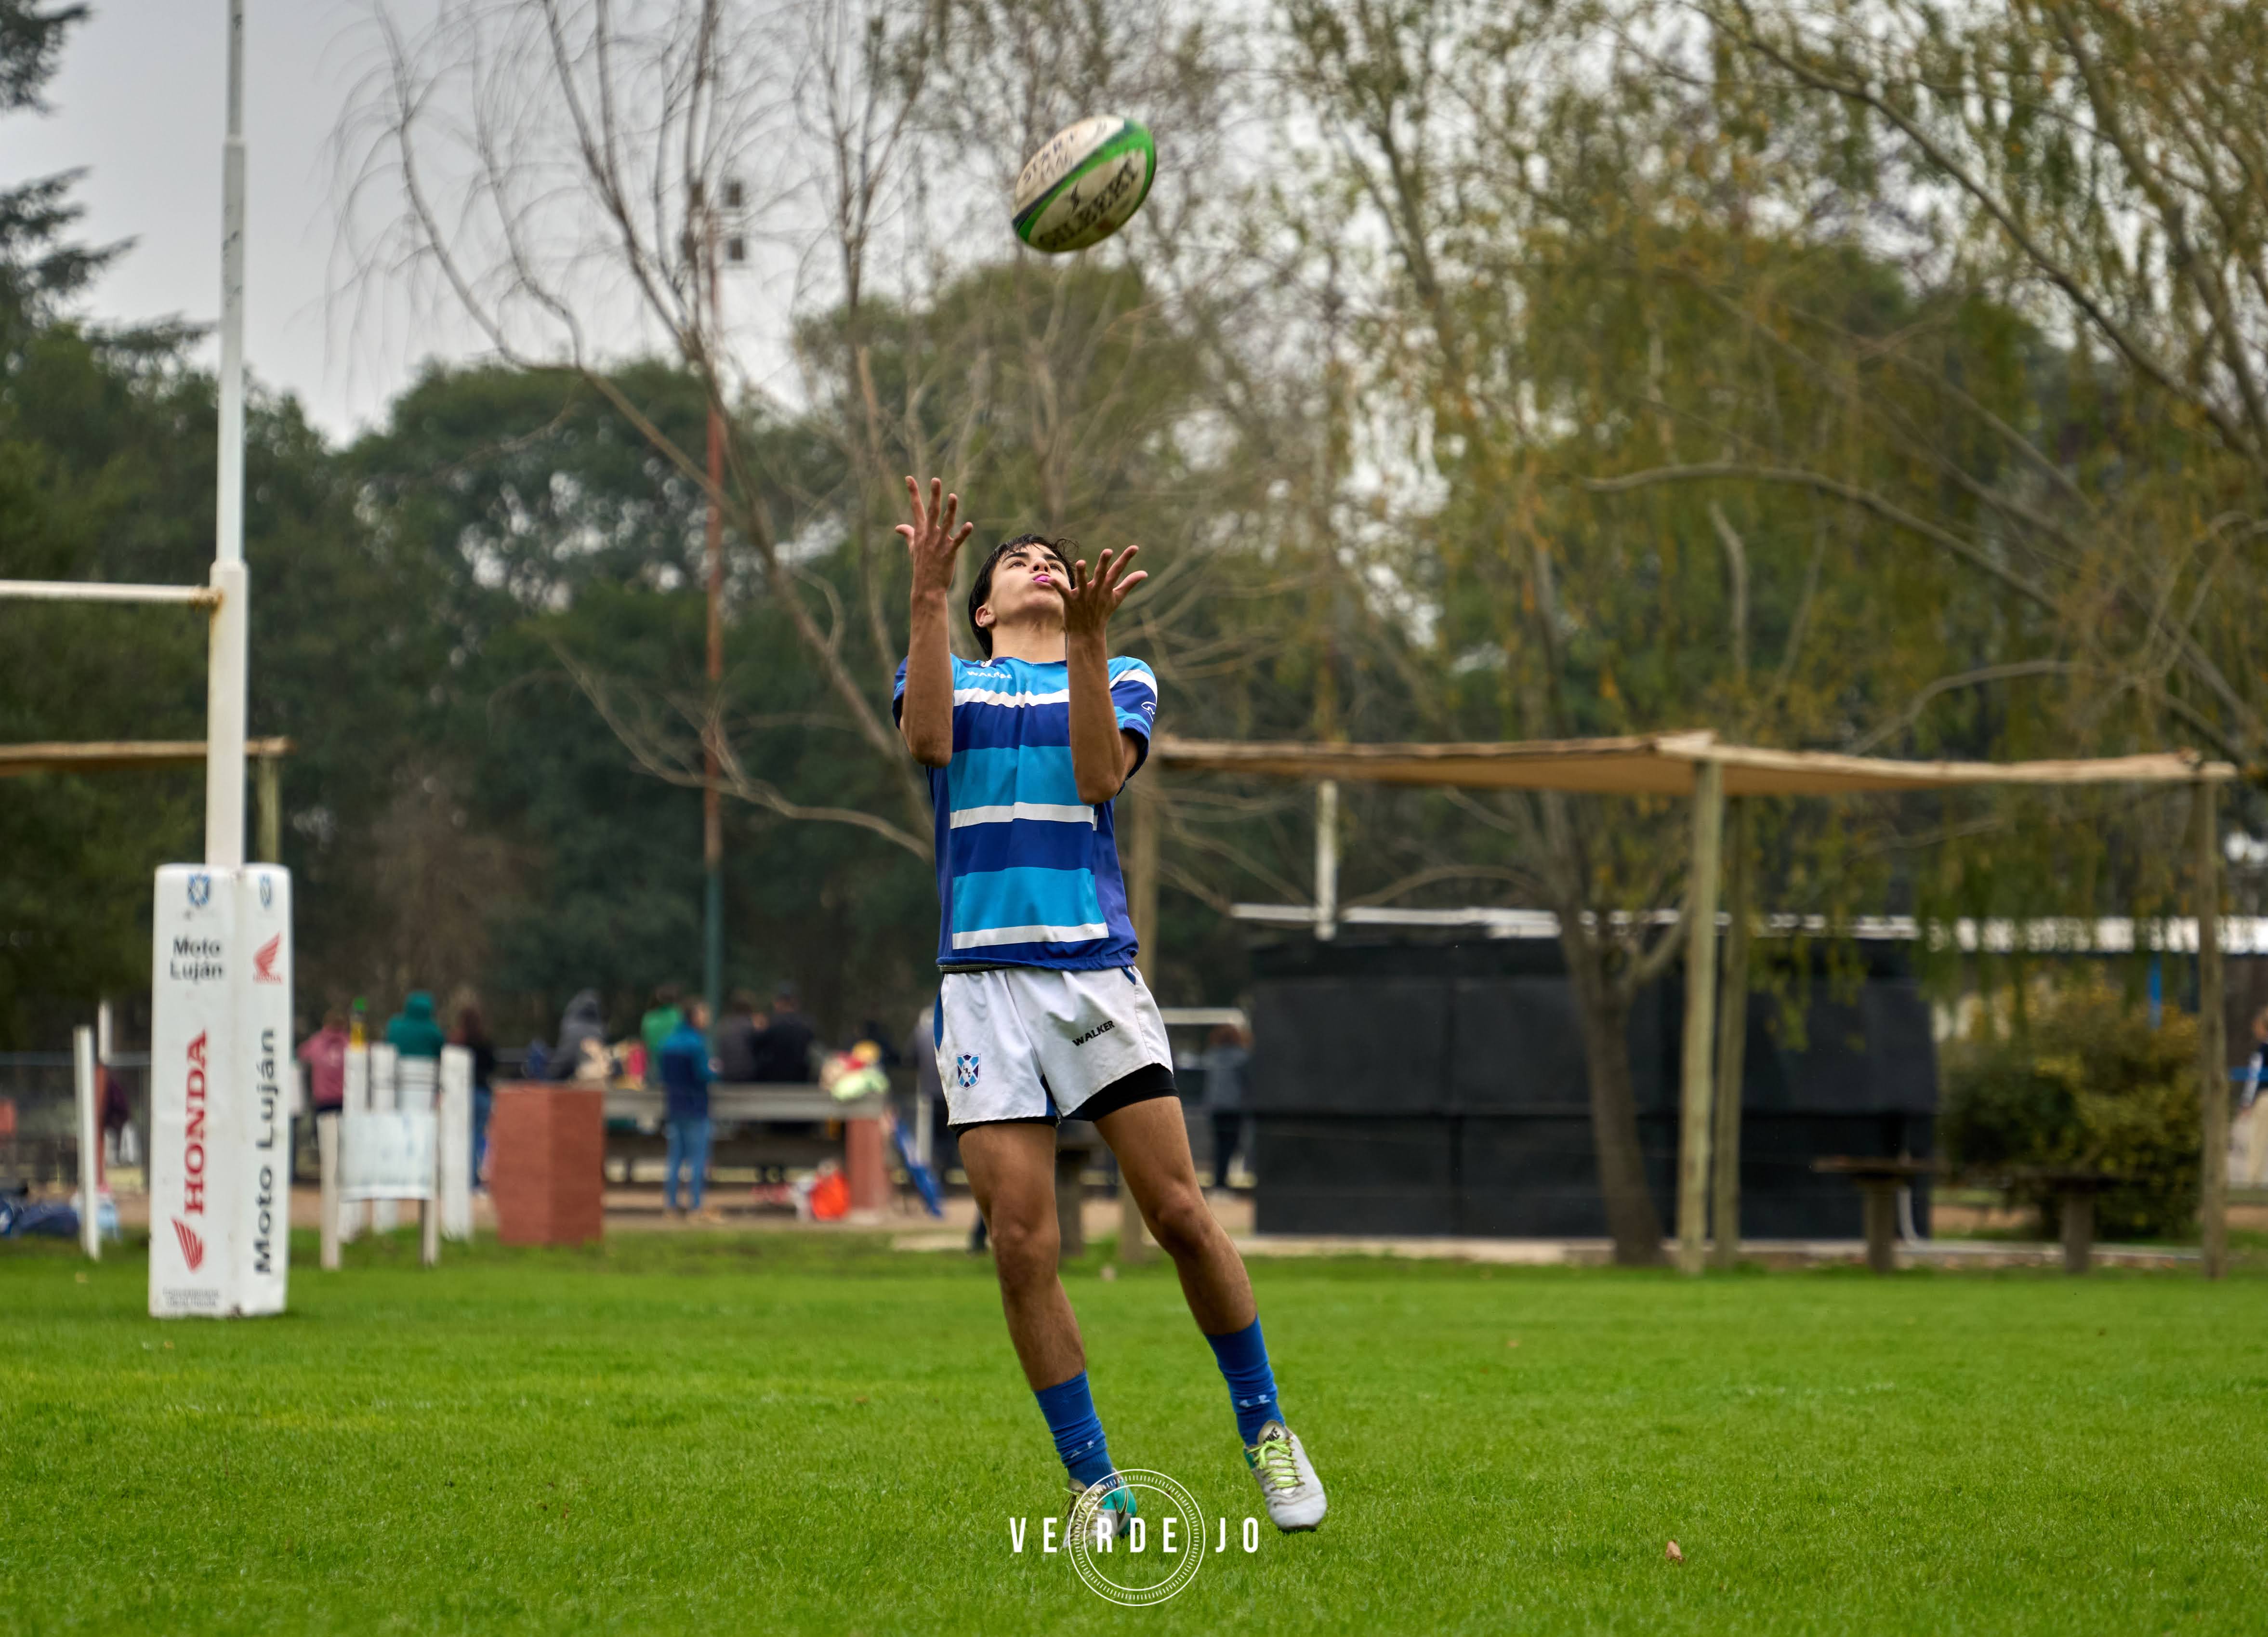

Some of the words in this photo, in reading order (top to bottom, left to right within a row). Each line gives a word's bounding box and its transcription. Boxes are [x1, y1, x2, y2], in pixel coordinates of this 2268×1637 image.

[173, 937, 221, 956] Moto
[1072, 1020, 1115, 1047] WALKER
[184, 1029, 208, 1215] HONDA
[256, 1029, 279, 1150] Luján
[253, 1165, 273, 1274] Moto
